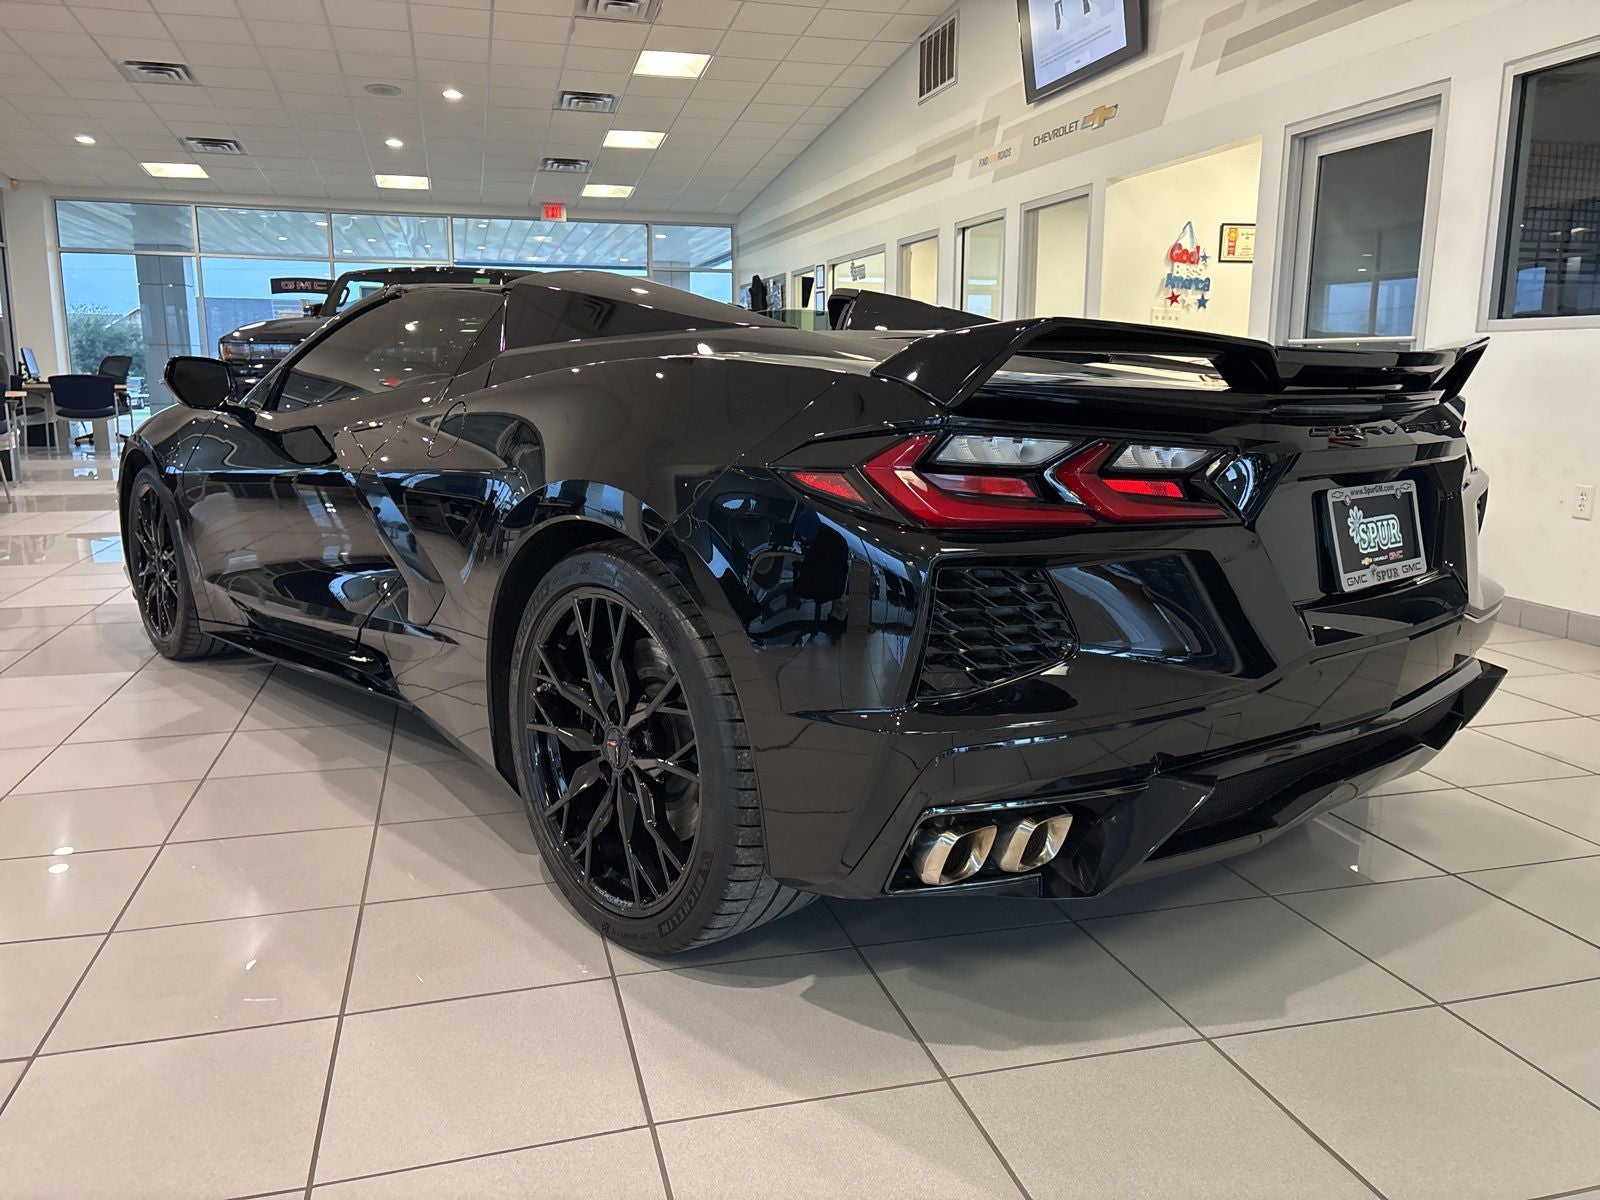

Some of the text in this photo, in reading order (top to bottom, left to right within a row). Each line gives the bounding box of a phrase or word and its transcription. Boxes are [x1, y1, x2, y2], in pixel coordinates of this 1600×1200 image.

[1033, 120, 1079, 147] CHEVROLET
[281, 281, 327, 290] GMC
[1350, 485, 1395, 496] www.SpurGM.com
[1359, 518, 1402, 551] SPUR
[1346, 561, 1422, 587] GMC SPUR GMC
